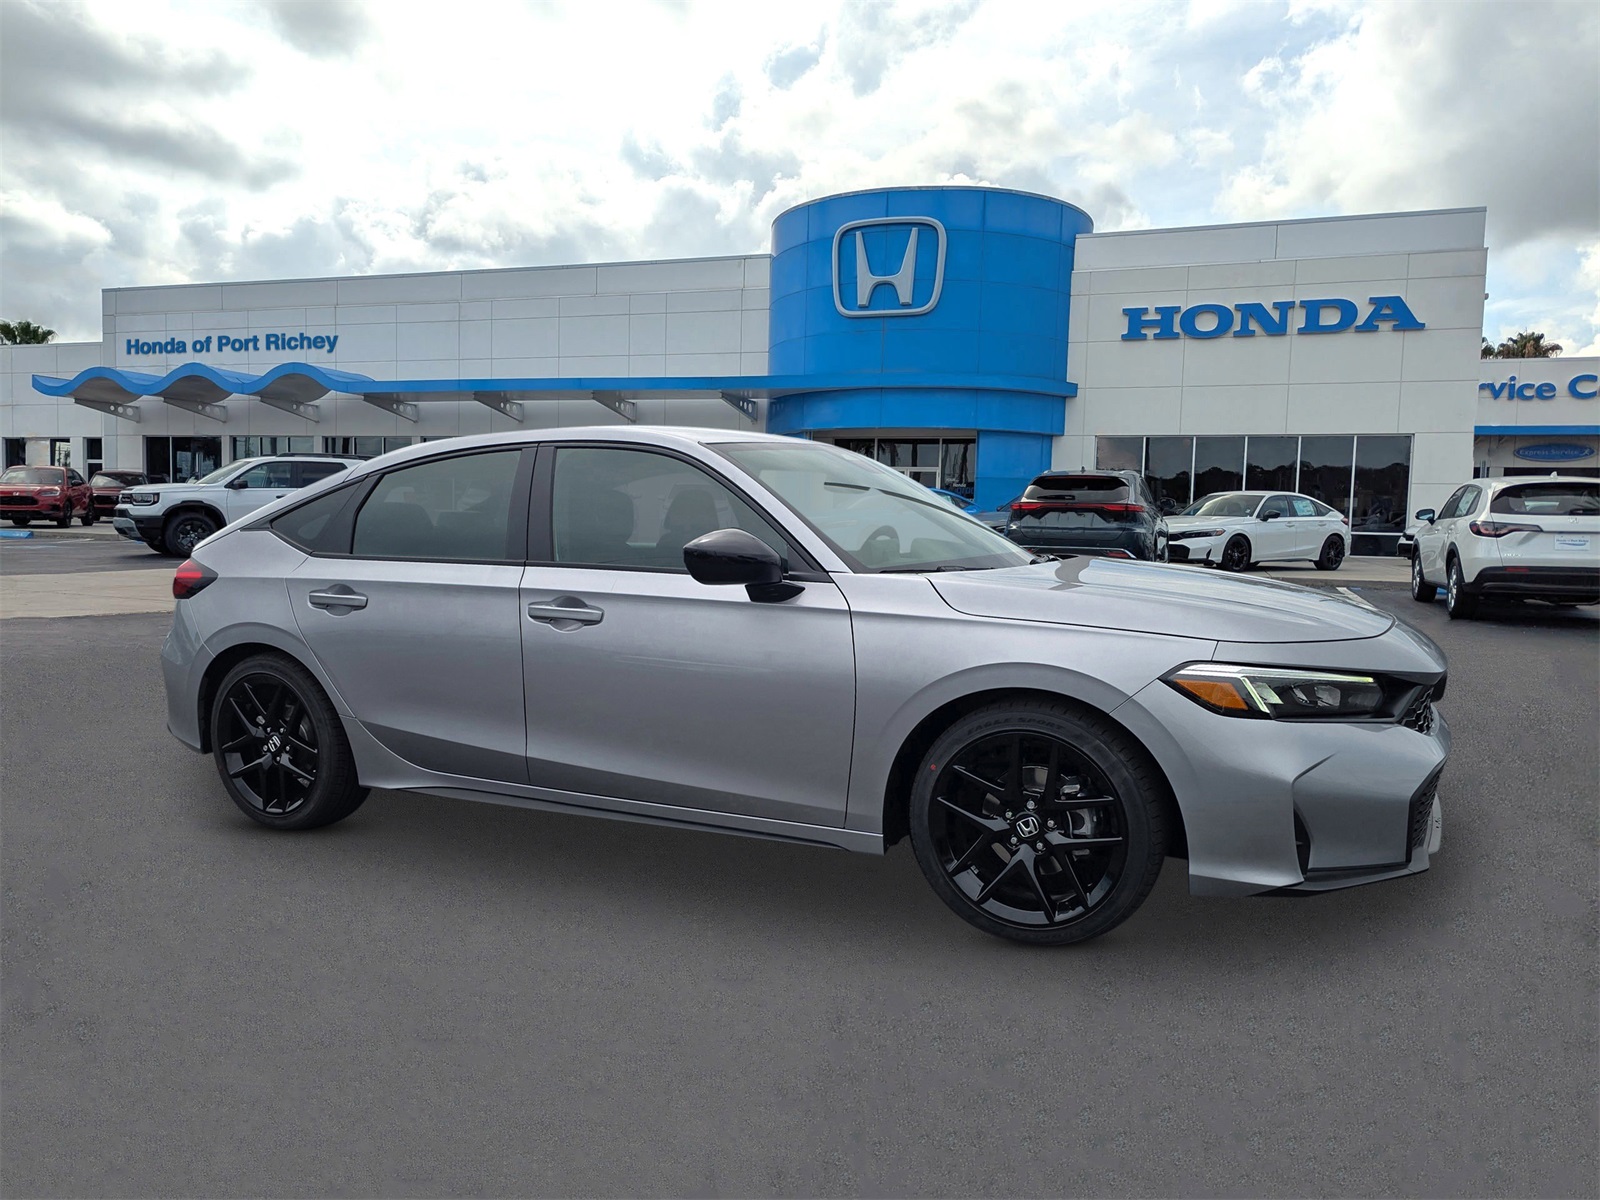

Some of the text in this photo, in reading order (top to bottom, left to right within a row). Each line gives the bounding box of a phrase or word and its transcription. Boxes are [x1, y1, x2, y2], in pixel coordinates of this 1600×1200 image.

[1121, 295, 1426, 341] HONDA
[126, 333, 339, 355] Honda of Port Richey
[1568, 373, 1600, 400] C
[1519, 448, 1549, 456] Express
